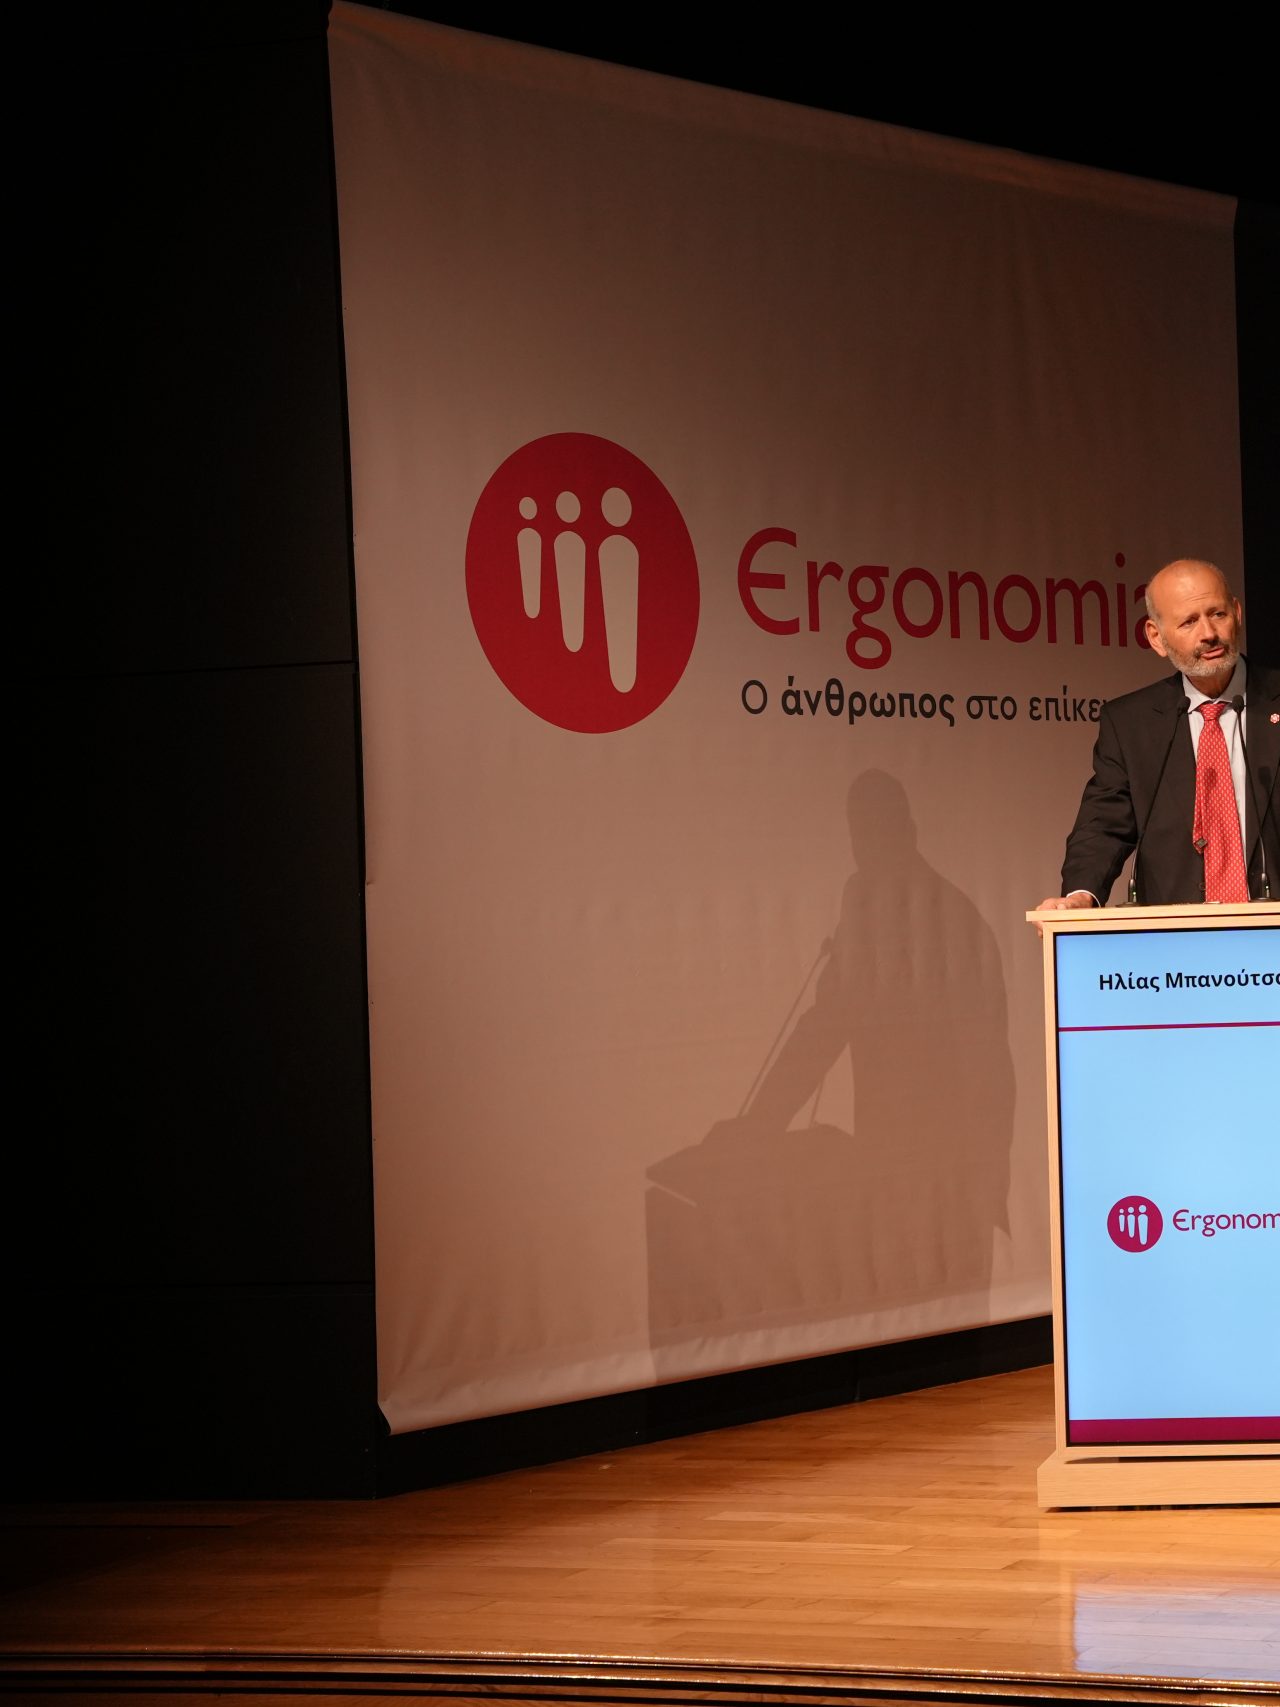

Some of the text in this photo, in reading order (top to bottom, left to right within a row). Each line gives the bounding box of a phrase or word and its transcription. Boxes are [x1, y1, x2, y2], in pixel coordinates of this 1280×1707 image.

[741, 675, 1107, 727] Ο άνθρωπος στο επίκε
[1099, 972, 1160, 992] Ηλίας
